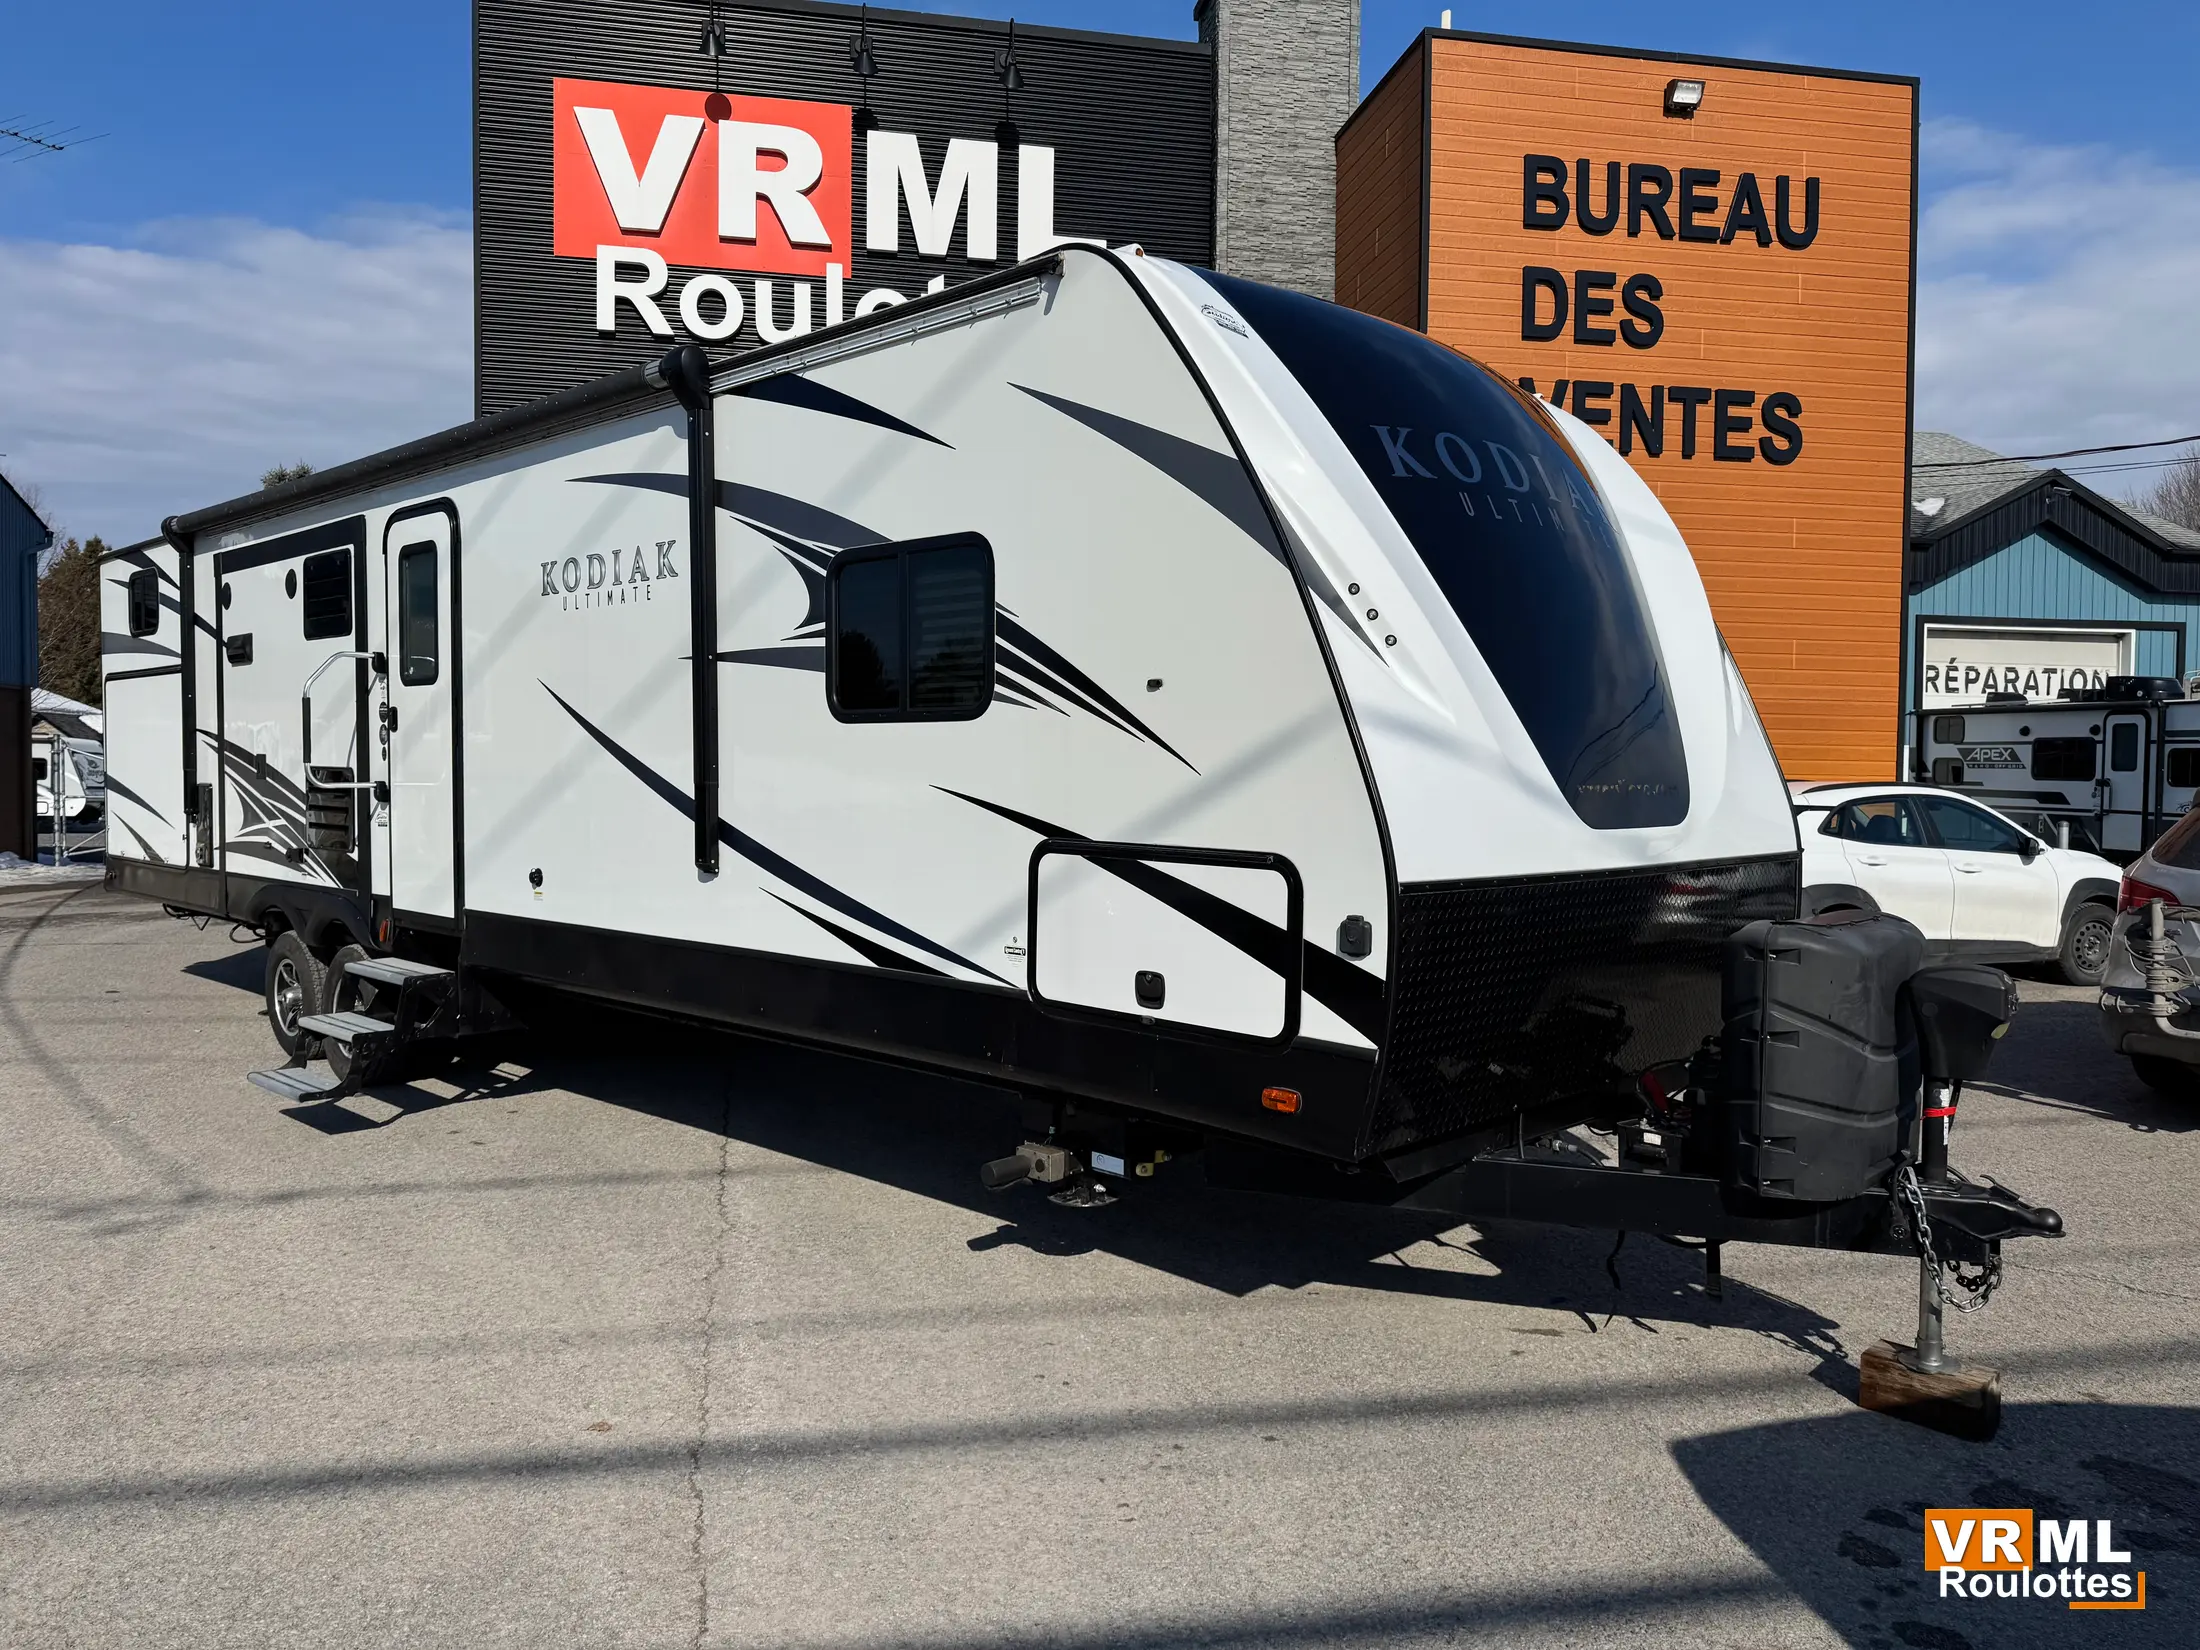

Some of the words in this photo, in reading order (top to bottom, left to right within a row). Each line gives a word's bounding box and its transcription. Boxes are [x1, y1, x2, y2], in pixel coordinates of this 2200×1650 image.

[573, 106, 1107, 262] VRML
[1523, 154, 1820, 250] BUREAU
[595, 244, 946, 344] Roul
[1521, 265, 1664, 349] DES
[541, 539, 679, 597] KODIAK
[562, 584, 651, 612] ULTIMATE
[1925, 656, 2110, 696] RÉPARATION
[1966, 747, 2012, 762] APEX
